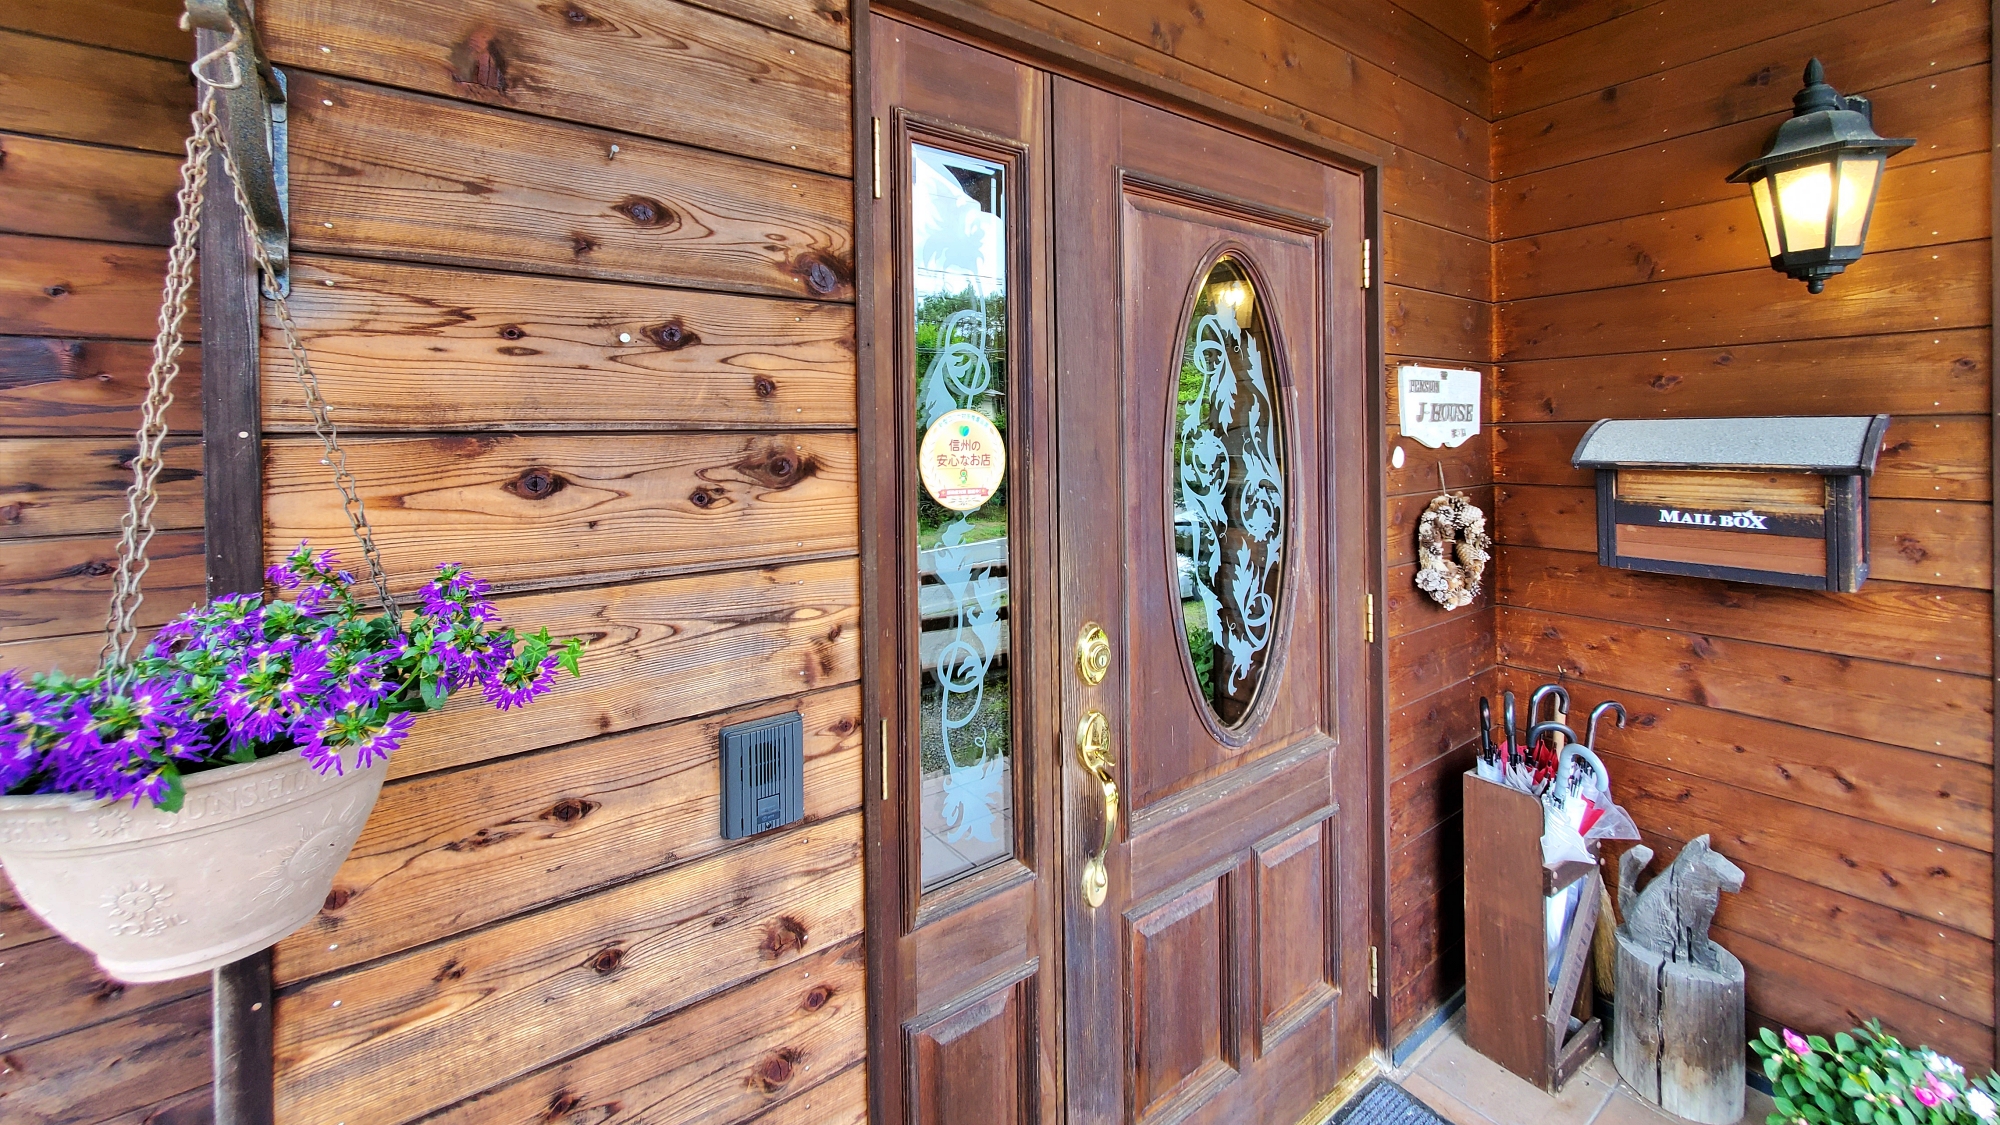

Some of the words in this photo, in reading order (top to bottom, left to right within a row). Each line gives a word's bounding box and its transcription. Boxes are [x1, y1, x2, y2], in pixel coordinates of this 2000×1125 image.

[1408, 379, 1440, 393] PENSION
[948, 439, 981, 452] 信州の
[936, 453, 991, 467] 安心なお店
[1658, 509, 1717, 526] MAIL
[1719, 514, 1768, 530] BOX
